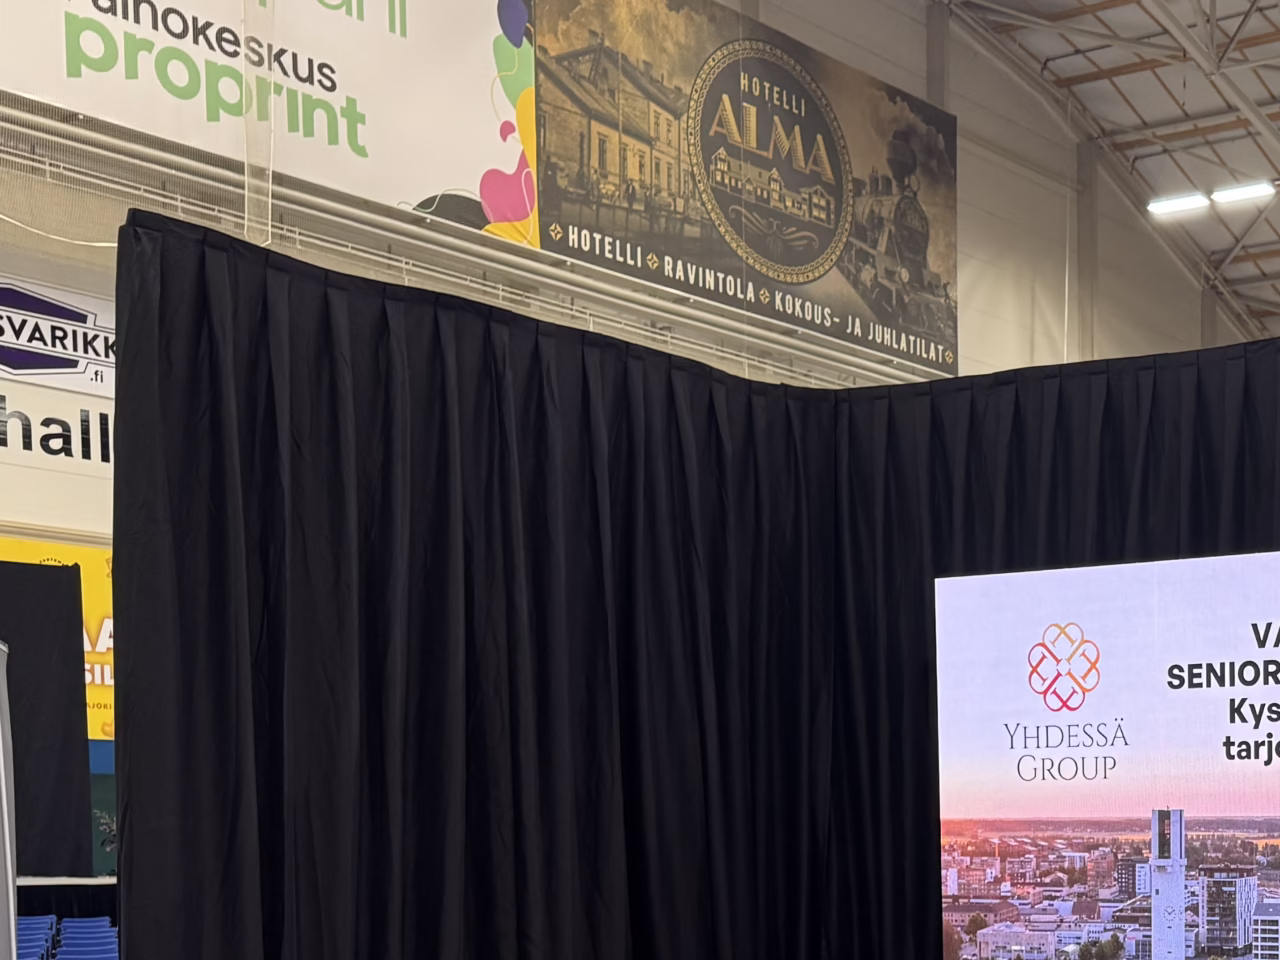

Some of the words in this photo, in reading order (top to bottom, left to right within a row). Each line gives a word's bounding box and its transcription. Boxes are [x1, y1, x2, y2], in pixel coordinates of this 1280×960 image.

[64, 9, 369, 158] proprint
[740, 71, 806, 118] HOTELLI
[708, 93, 836, 186] ALMA
[568, 224, 642, 269] HOTELLI
[664, 255, 755, 304] RAVINTOLA
[775, 290, 840, 328] KOKOUS-
[846, 315, 862, 338] JA
[868, 322, 945, 364] JUHLATILAT
[90, 369, 104, 384] .fi
[1003, 717, 1130, 750] YHDESSÄ
[1016, 754, 1117, 782] GROUP
